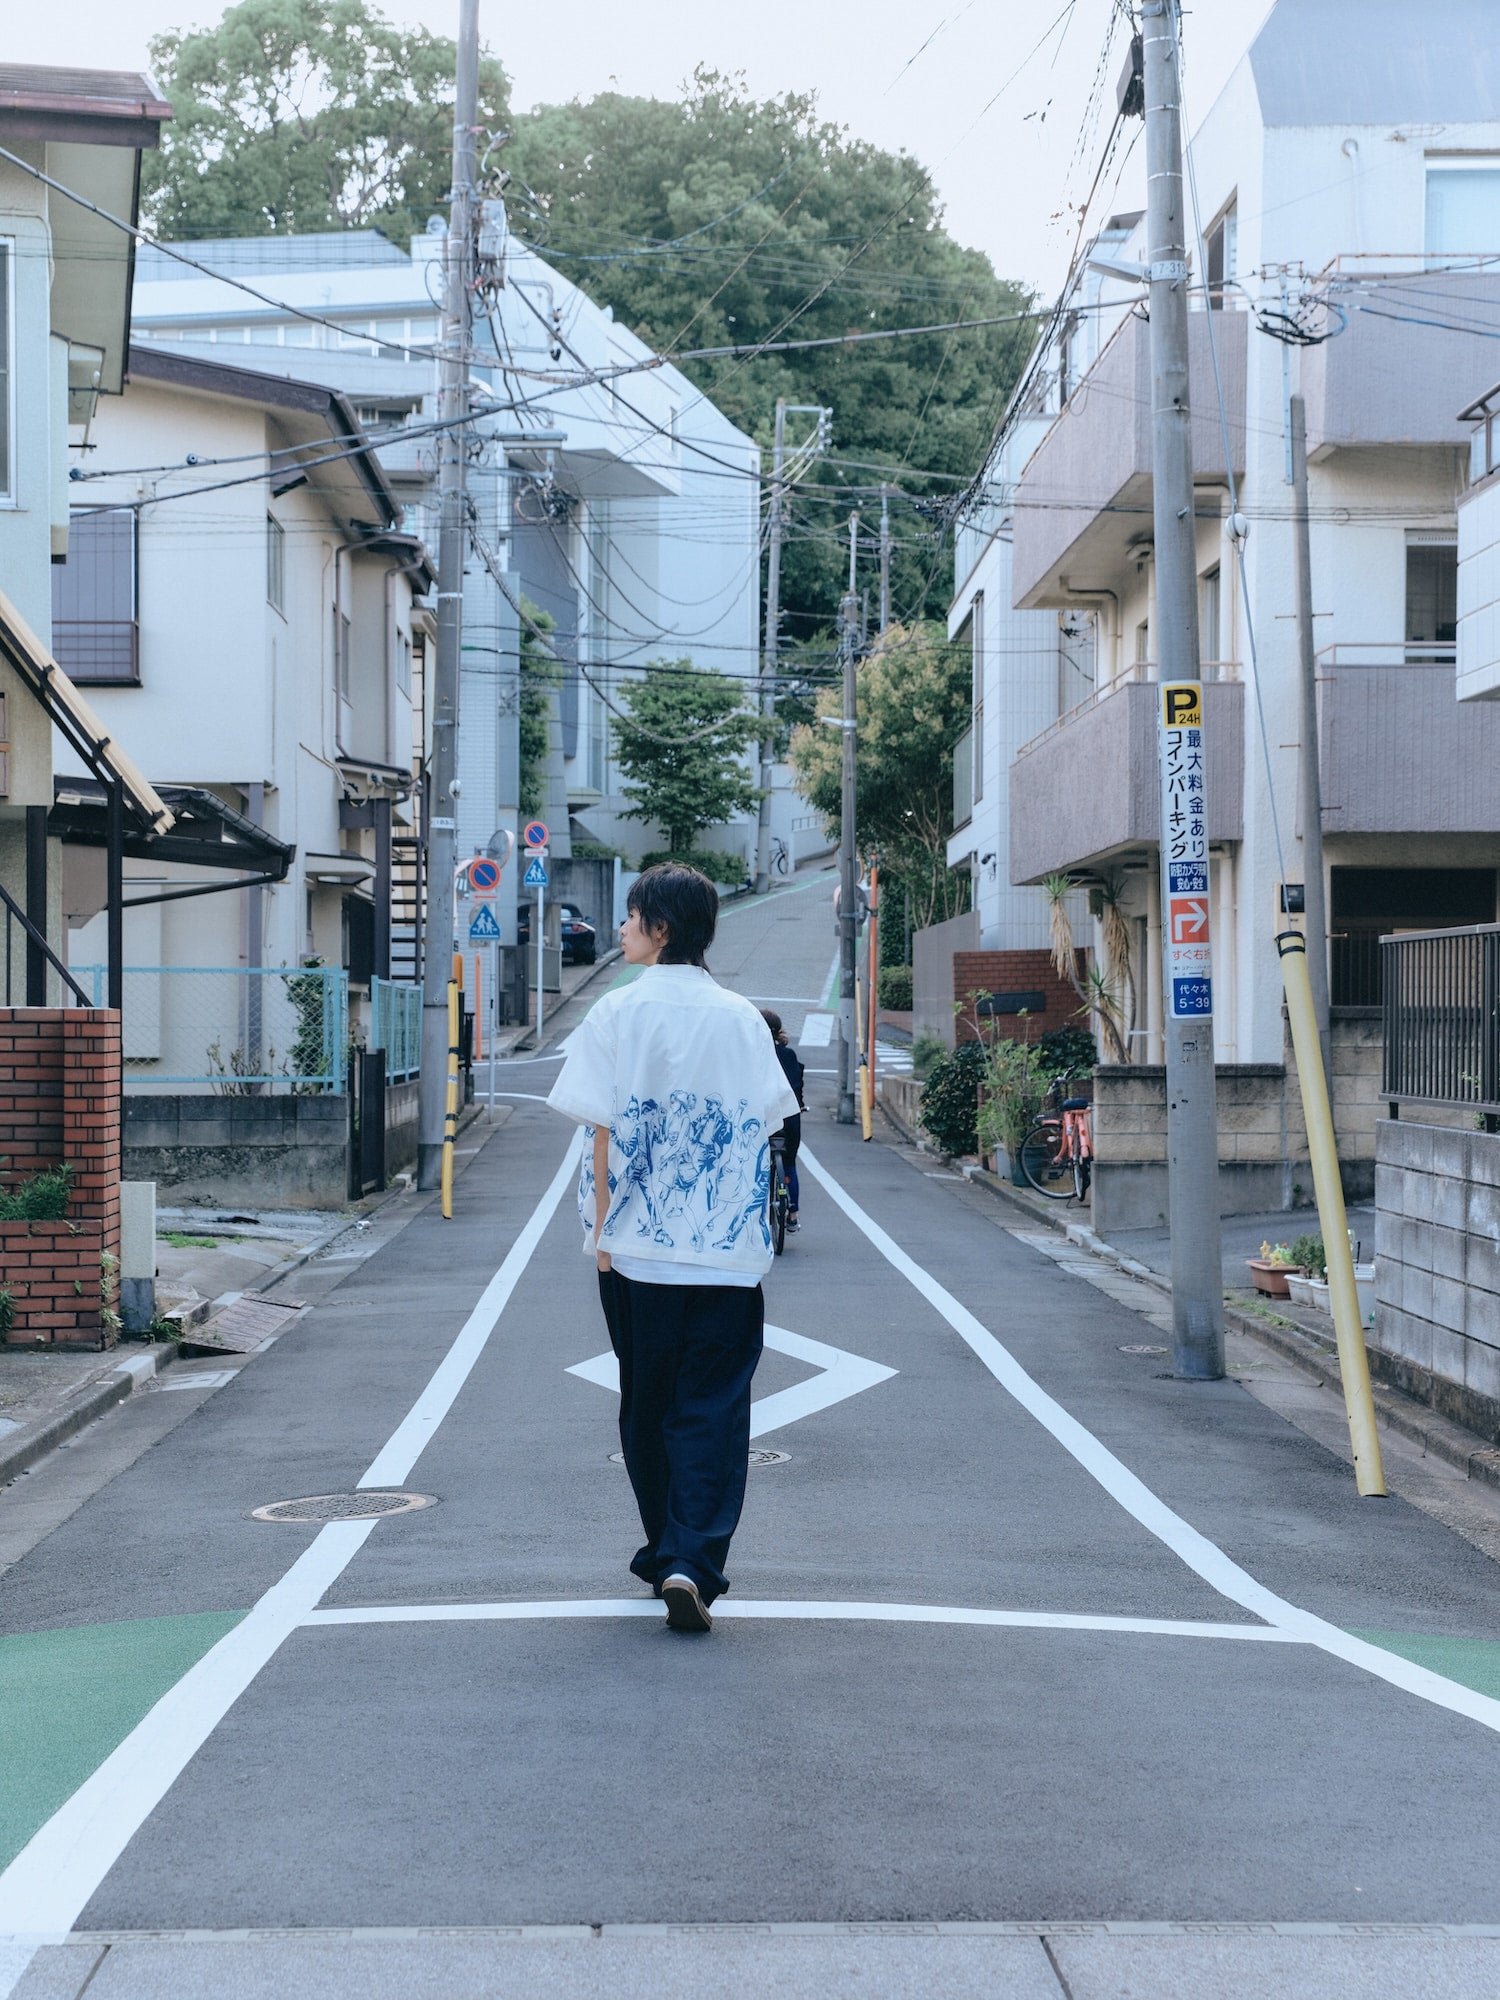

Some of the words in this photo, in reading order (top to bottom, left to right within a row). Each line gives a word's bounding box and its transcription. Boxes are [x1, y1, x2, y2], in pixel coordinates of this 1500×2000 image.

[1166, 689, 1197, 724] P
[1179, 713, 1201, 725] 24H
[1167, 731, 1188, 859] コインパーキング
[1187, 730, 1205, 858] 最大料金あり
[1179, 984, 1209, 995] 代々木
[1179, 997, 1210, 1008] 5-39
